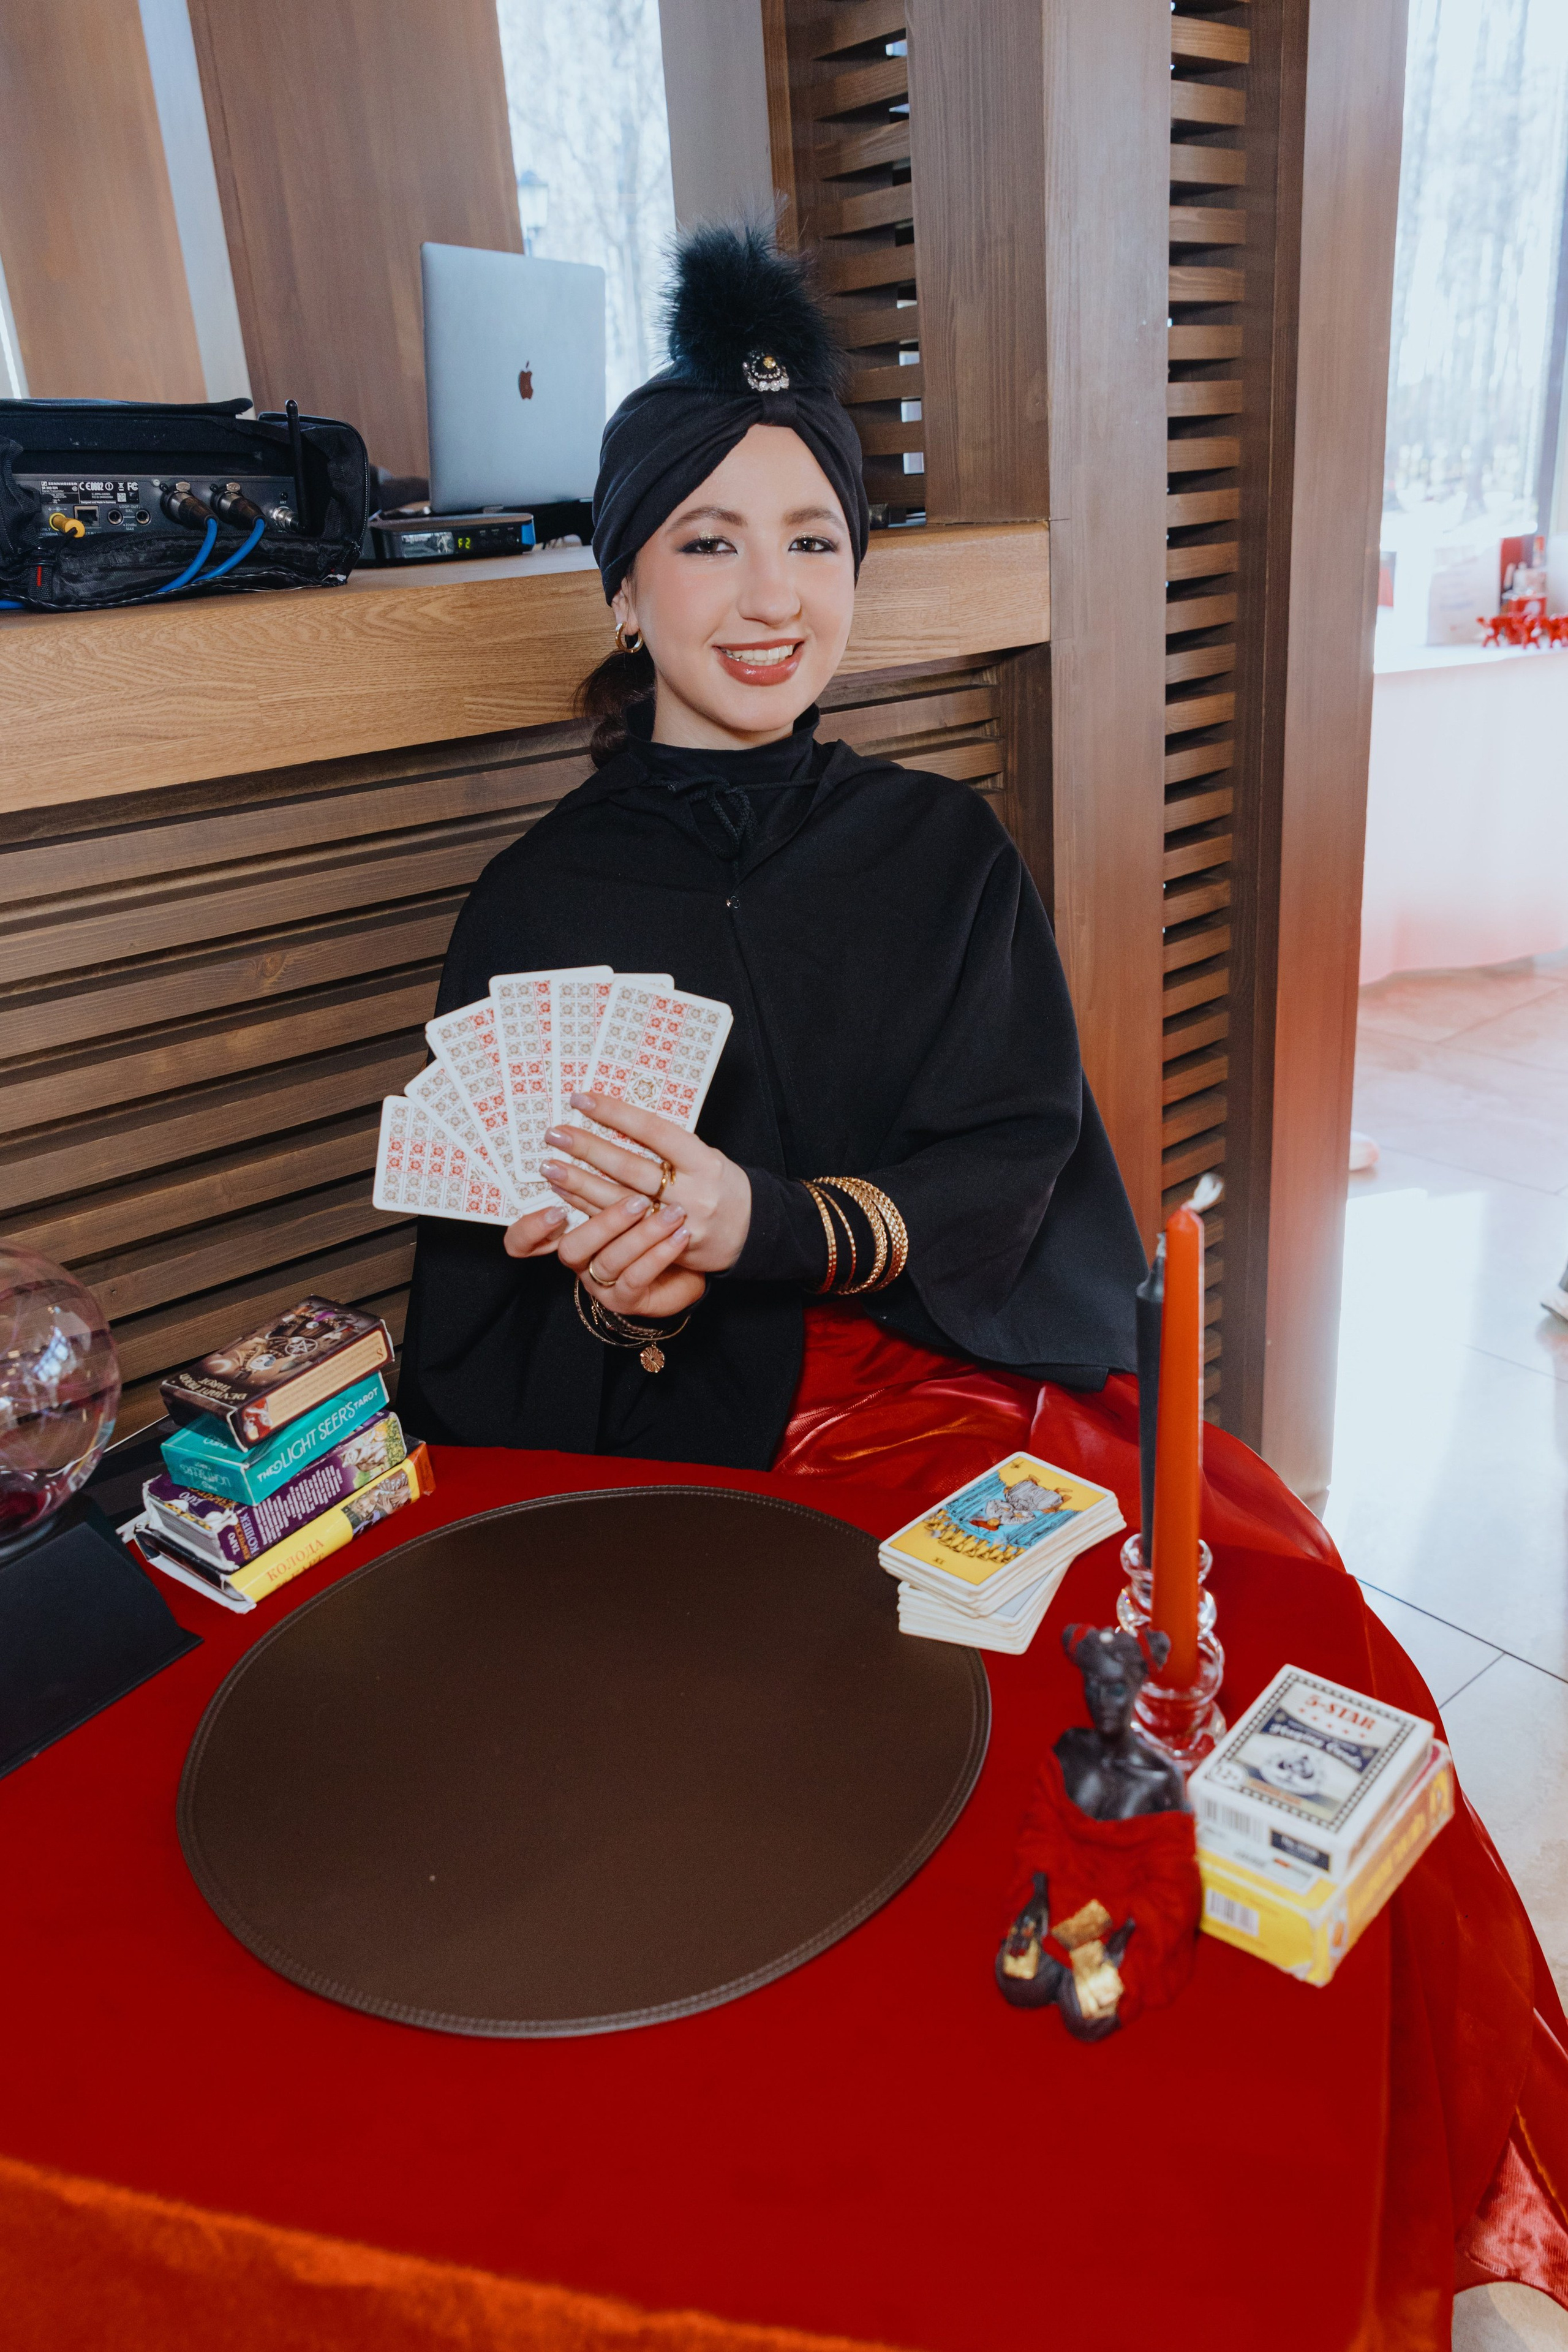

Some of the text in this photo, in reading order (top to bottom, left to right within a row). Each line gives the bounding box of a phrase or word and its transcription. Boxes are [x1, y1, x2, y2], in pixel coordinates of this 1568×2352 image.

[280, 1428, 317, 1469] LIGHT
[318, 1401, 356, 1441] SEER'S
[353, 1387, 378, 1410] TAROT
[227, 1532, 241, 1556] ТАРО
[239, 1512, 260, 1556] КОШЕК
[266, 1539, 324, 1582] КОЛОДА
[1305, 1694, 1376, 1730] 5-STAR
